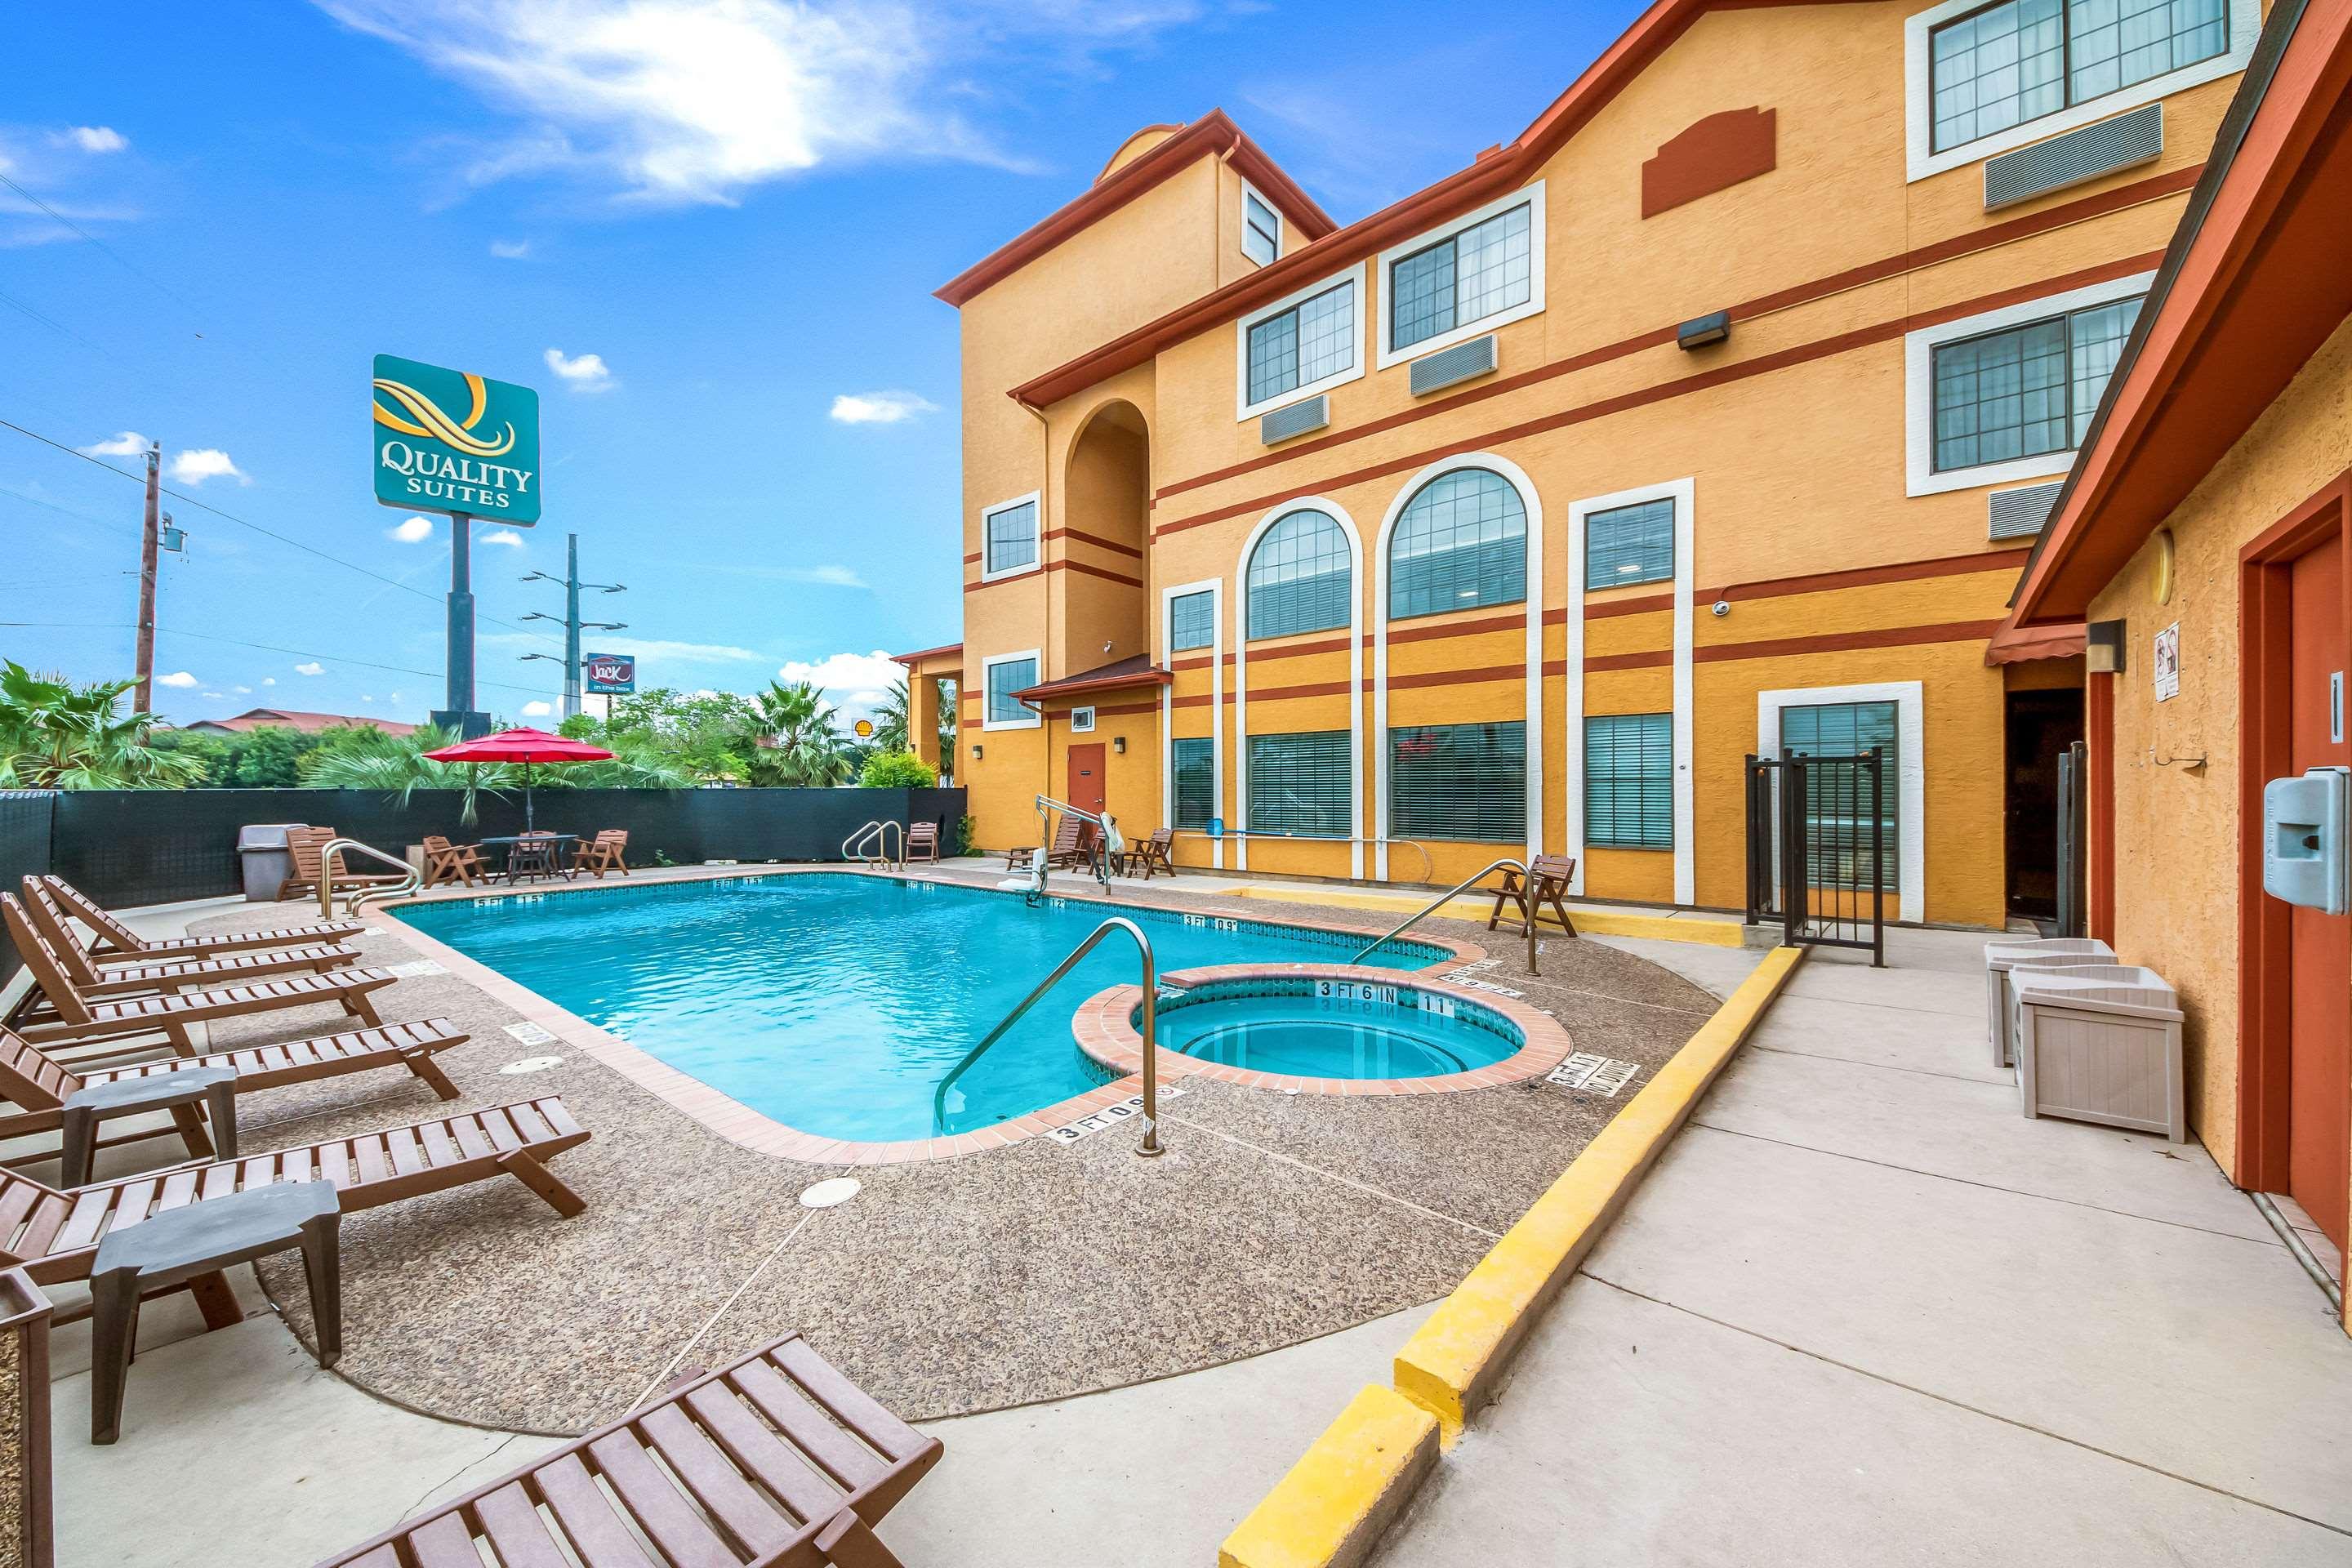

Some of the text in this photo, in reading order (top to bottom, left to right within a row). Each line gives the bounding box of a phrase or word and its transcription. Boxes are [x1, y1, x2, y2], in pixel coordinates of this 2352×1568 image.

[381, 441, 532, 492] QUALITY
[407, 478, 510, 508] SUITES
[592, 664, 630, 682] Jack
[479, 899, 485, 907] 5
[490, 898, 502, 906] FT
[1187, 915, 1192, 925] 3
[1195, 916, 1203, 928] FT
[1321, 982, 1330, 996] 3
[1338, 982, 1355, 998] FT
[1362, 985, 1372, 1000] 6
[1380, 987, 1395, 1004] IN
[1552, 1077, 1575, 1085] 3
[1057, 1128, 1080, 1138] 3
[1077, 1115, 1109, 1130] FT
